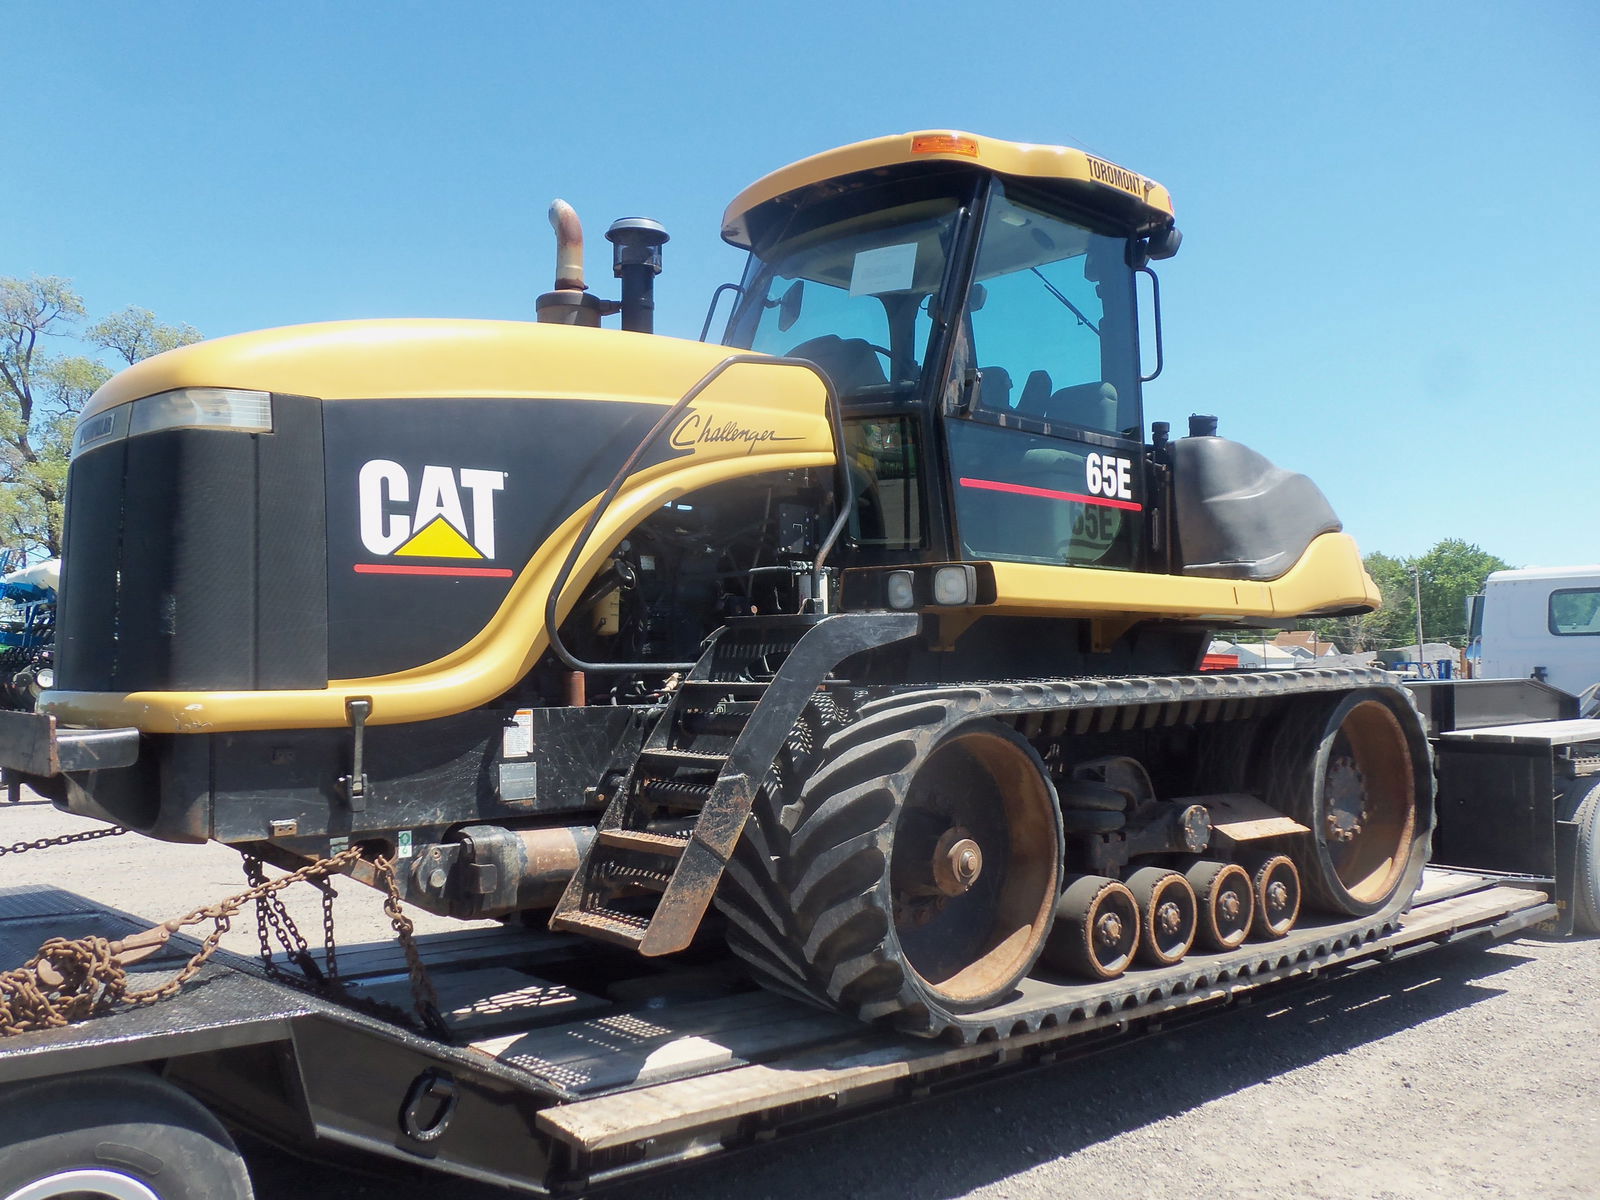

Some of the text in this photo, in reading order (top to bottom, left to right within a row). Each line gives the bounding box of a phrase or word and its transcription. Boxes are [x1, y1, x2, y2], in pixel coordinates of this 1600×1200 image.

[1087, 158, 1141, 195] TOROMONT
[672, 414, 806, 455] Challenger
[1086, 452, 1132, 500] 65E
[359, 459, 504, 560] CAT
